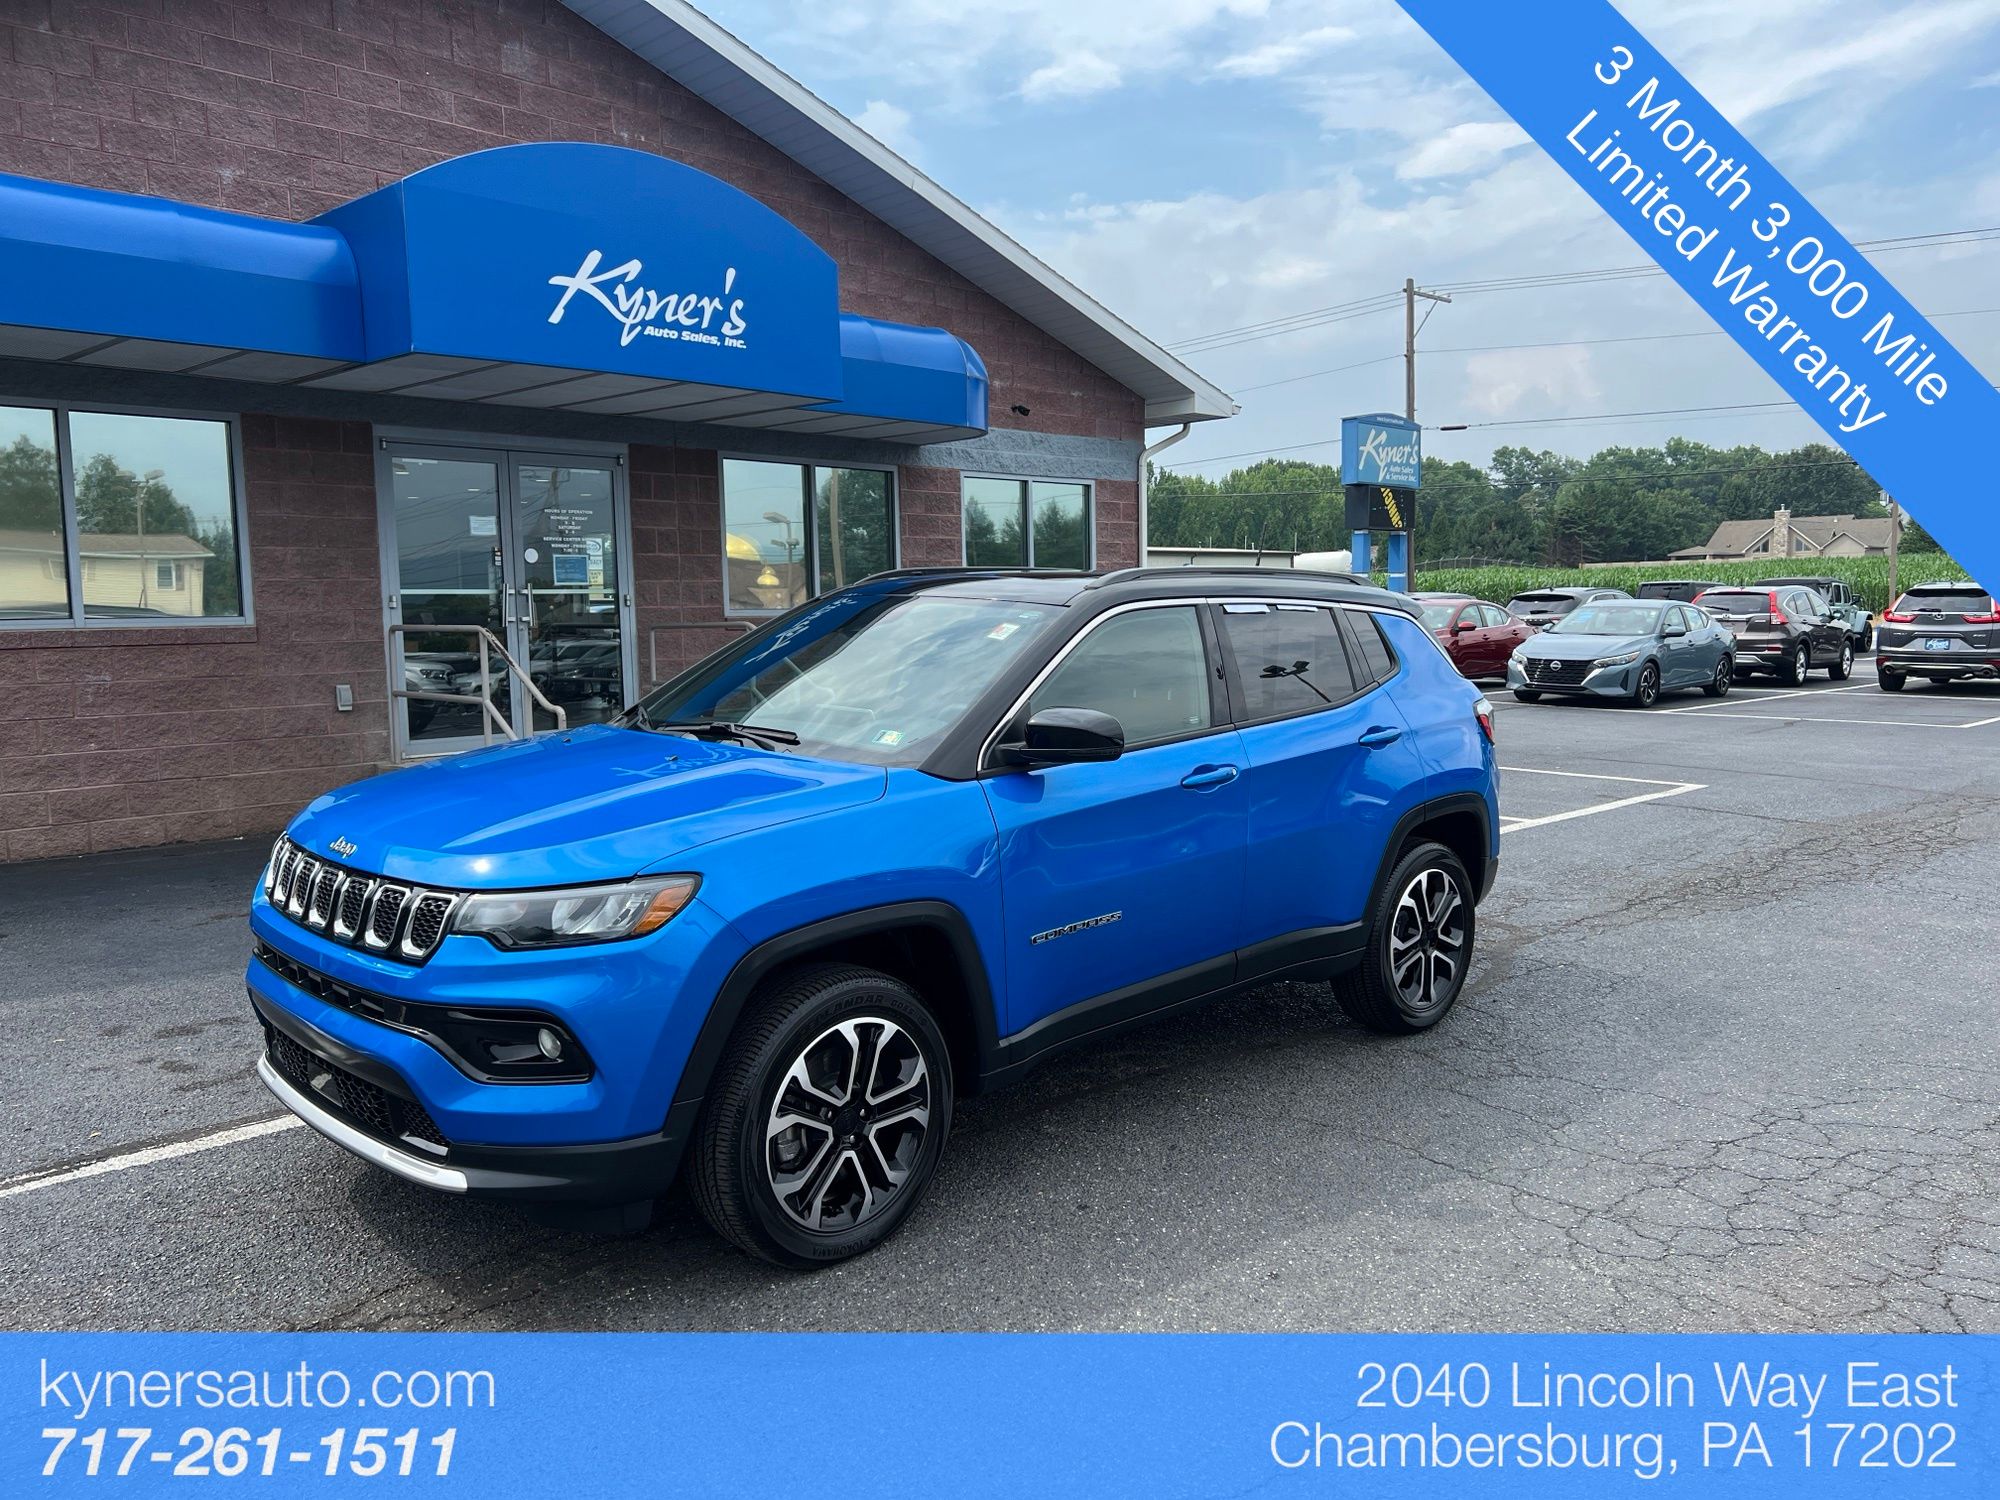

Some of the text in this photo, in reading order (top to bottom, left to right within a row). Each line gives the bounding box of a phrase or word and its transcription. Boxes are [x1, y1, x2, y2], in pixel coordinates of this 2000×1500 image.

[548, 250, 747, 346] Kyner's
[643, 325, 747, 349] Auto Sales, Inc.
[1359, 428, 1419, 482] Kyner's
[1390, 464, 1413, 474] Auto Sales
[1391, 473, 1408, 481] Service
[329, 836, 357, 859] Jeep
[1031, 910, 1122, 945] COMPASS
